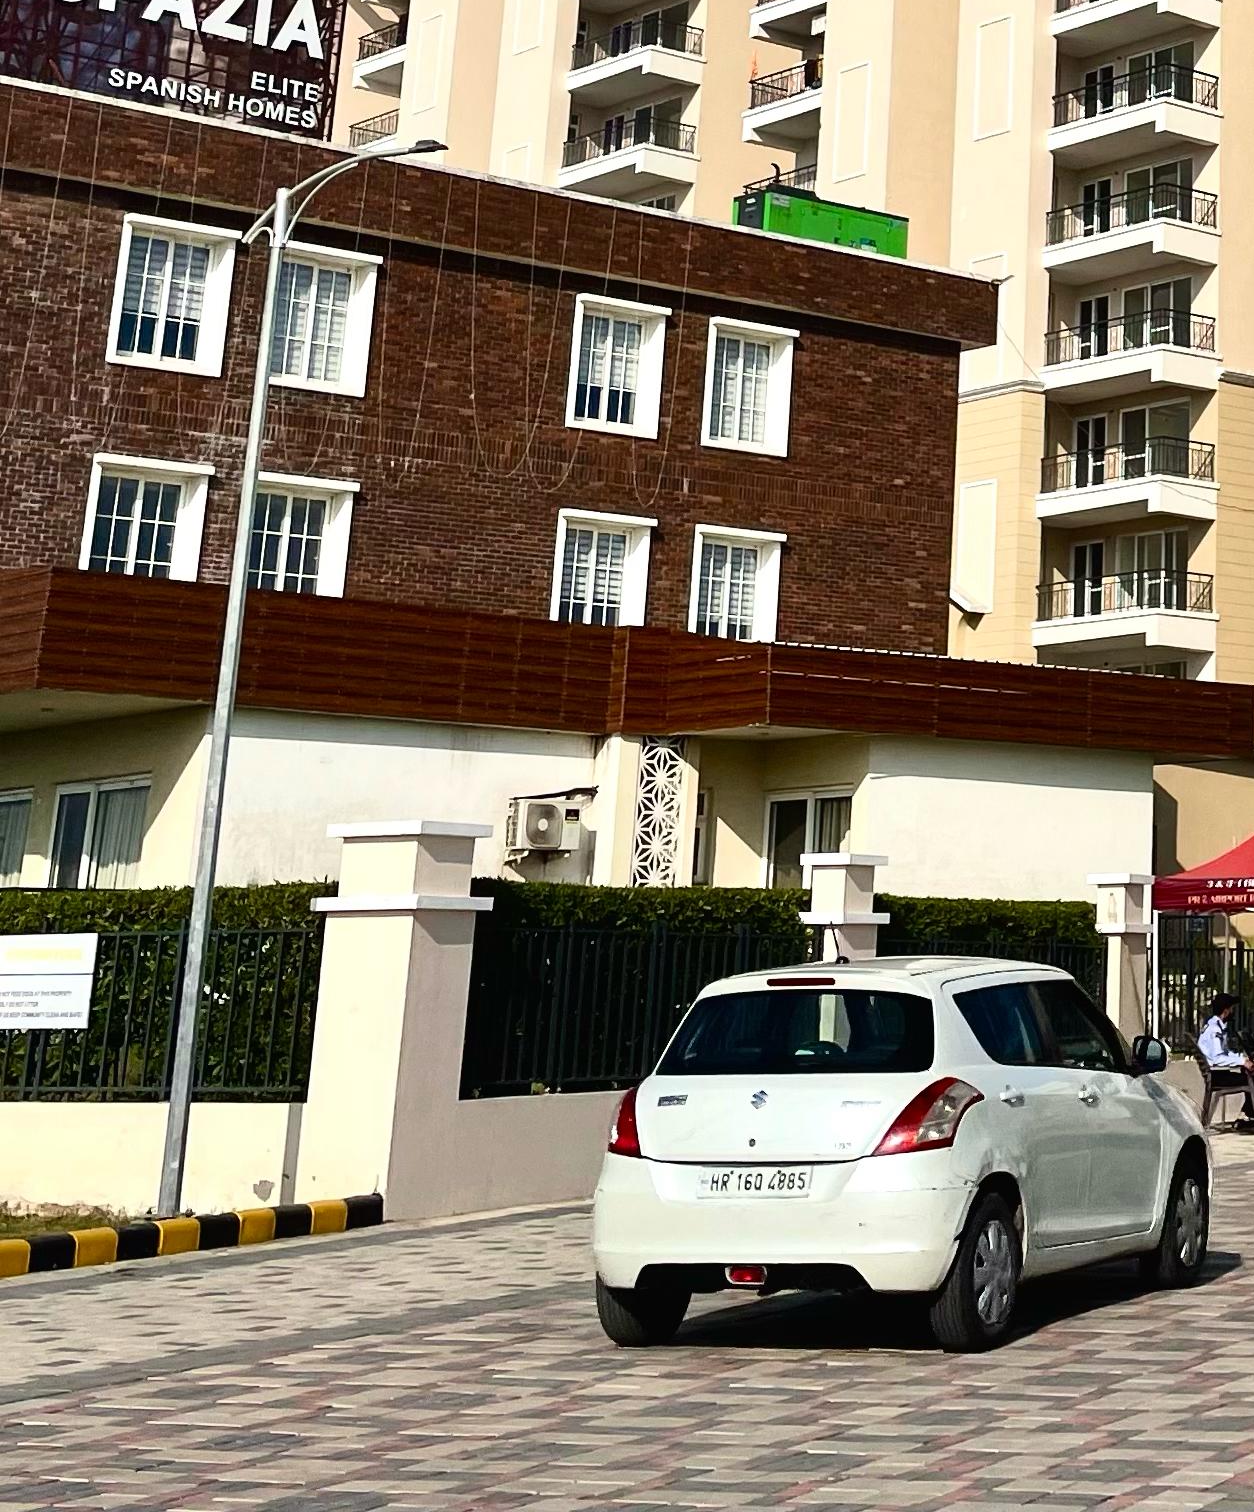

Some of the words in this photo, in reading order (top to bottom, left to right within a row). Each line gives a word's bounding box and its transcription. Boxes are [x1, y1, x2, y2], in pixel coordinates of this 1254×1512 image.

[108, 68, 220, 108] SPANISH
[228, 93, 317, 129] HOMES
[251, 71, 320, 103] ELITE
[710, 1173, 730, 1192] HR
